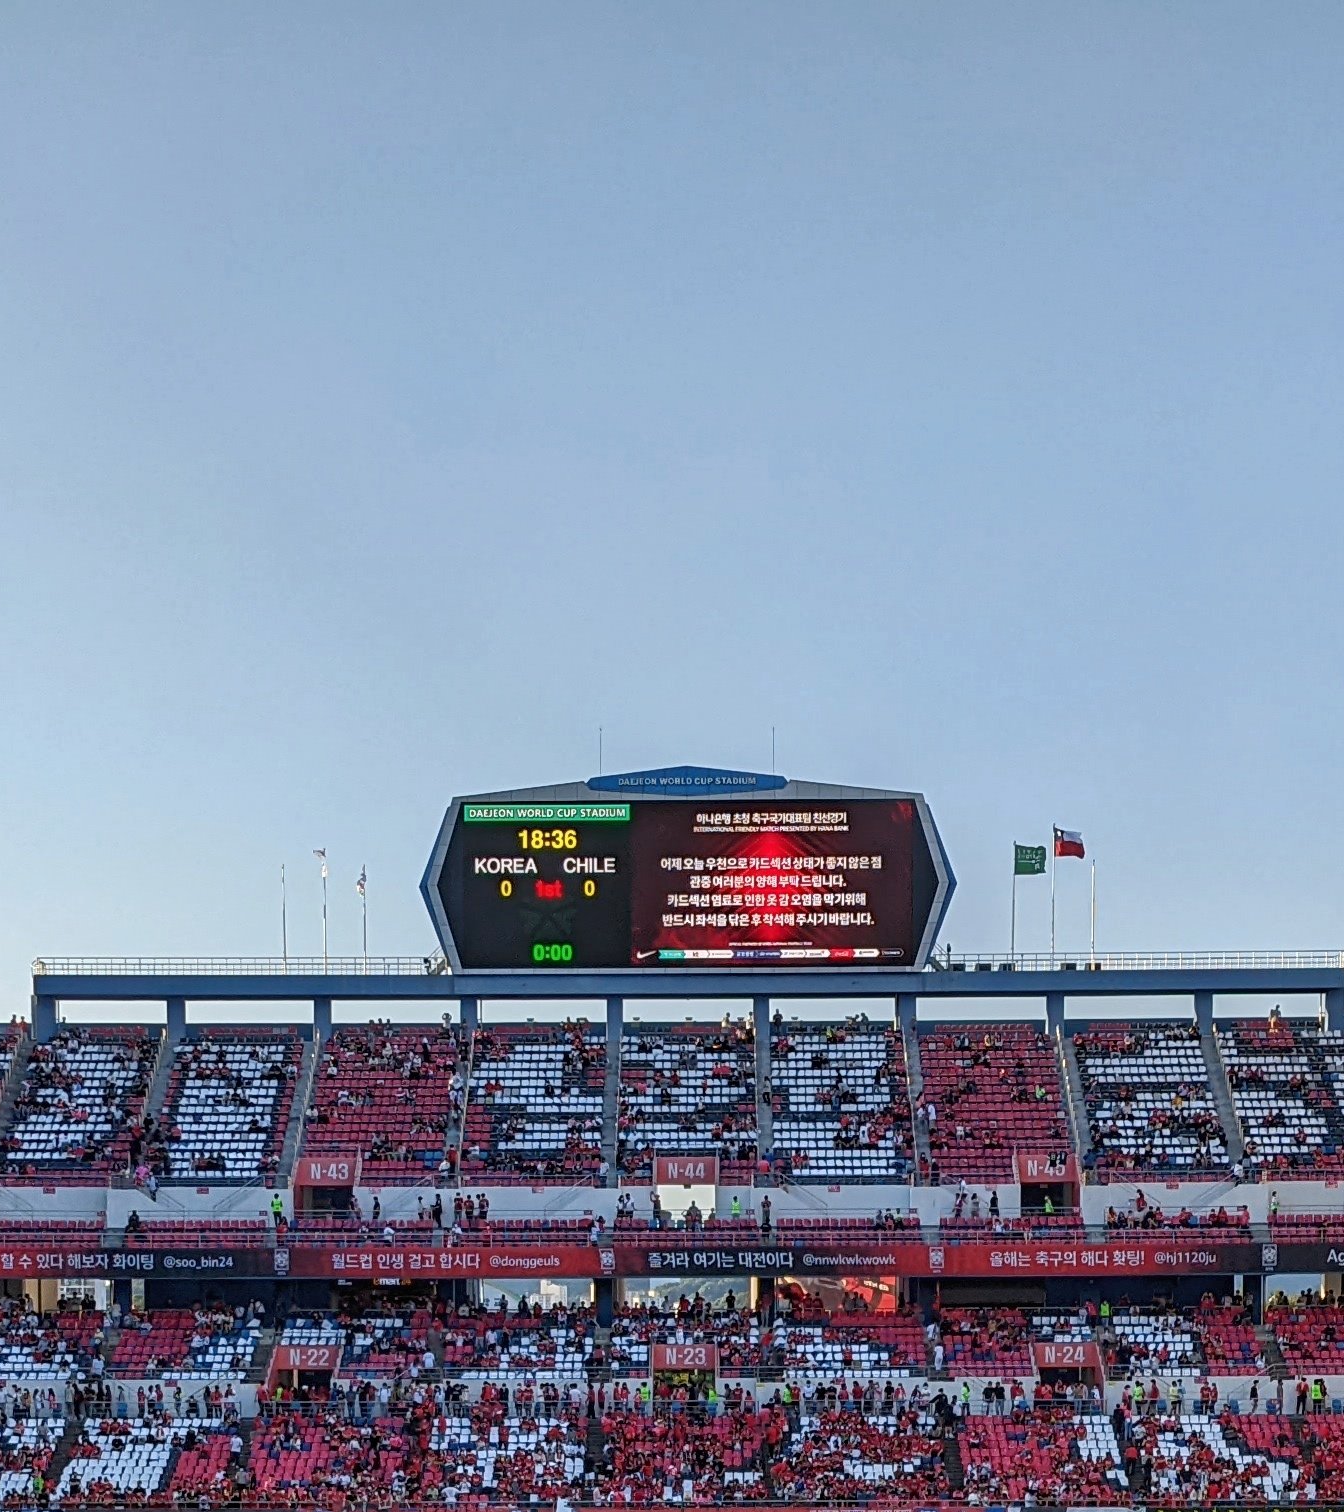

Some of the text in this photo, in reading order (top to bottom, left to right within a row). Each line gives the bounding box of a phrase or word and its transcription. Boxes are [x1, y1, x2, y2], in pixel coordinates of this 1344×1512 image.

[659, 777, 692, 787] WORLD
[694, 777, 713, 787] CUP
[715, 777, 757, 787] STADIUM
[469, 808, 626, 819] DAEJEON WORLD CUP STADIUM
[519, 829, 577, 850] 18:36
[474, 857, 616, 874] KOREA CHILE
[500, 880, 595, 898] 0 1st 0
[533, 944, 572, 961] 0:00
[310, 1163, 349, 1180] N-43
[668, 1162, 705, 1179] N-44
[0, 1253, 234, 1271] 할 수 있다 해보자 화이팅 @soo_bin24
[332, 1253, 560, 1269] 월드컵 인생 걸고 합시다 @donggeuls
[648, 1252, 690, 1269] 즐겨라
[693, 1252, 734, 1269] 여기는
[738, 1252, 794, 1269] 대전이다
[989, 1250, 1031, 1267] 올해는
[1036, 1250, 1077, 1267] 축구의
[1080, 1250, 1109, 1267] 해다
[1154, 1250, 1216, 1267] @hj1120ju
[289, 1348, 330, 1367] N-22
[665, 1346, 706, 1365] N-23
[1044, 1346, 1085, 1364] N-24
